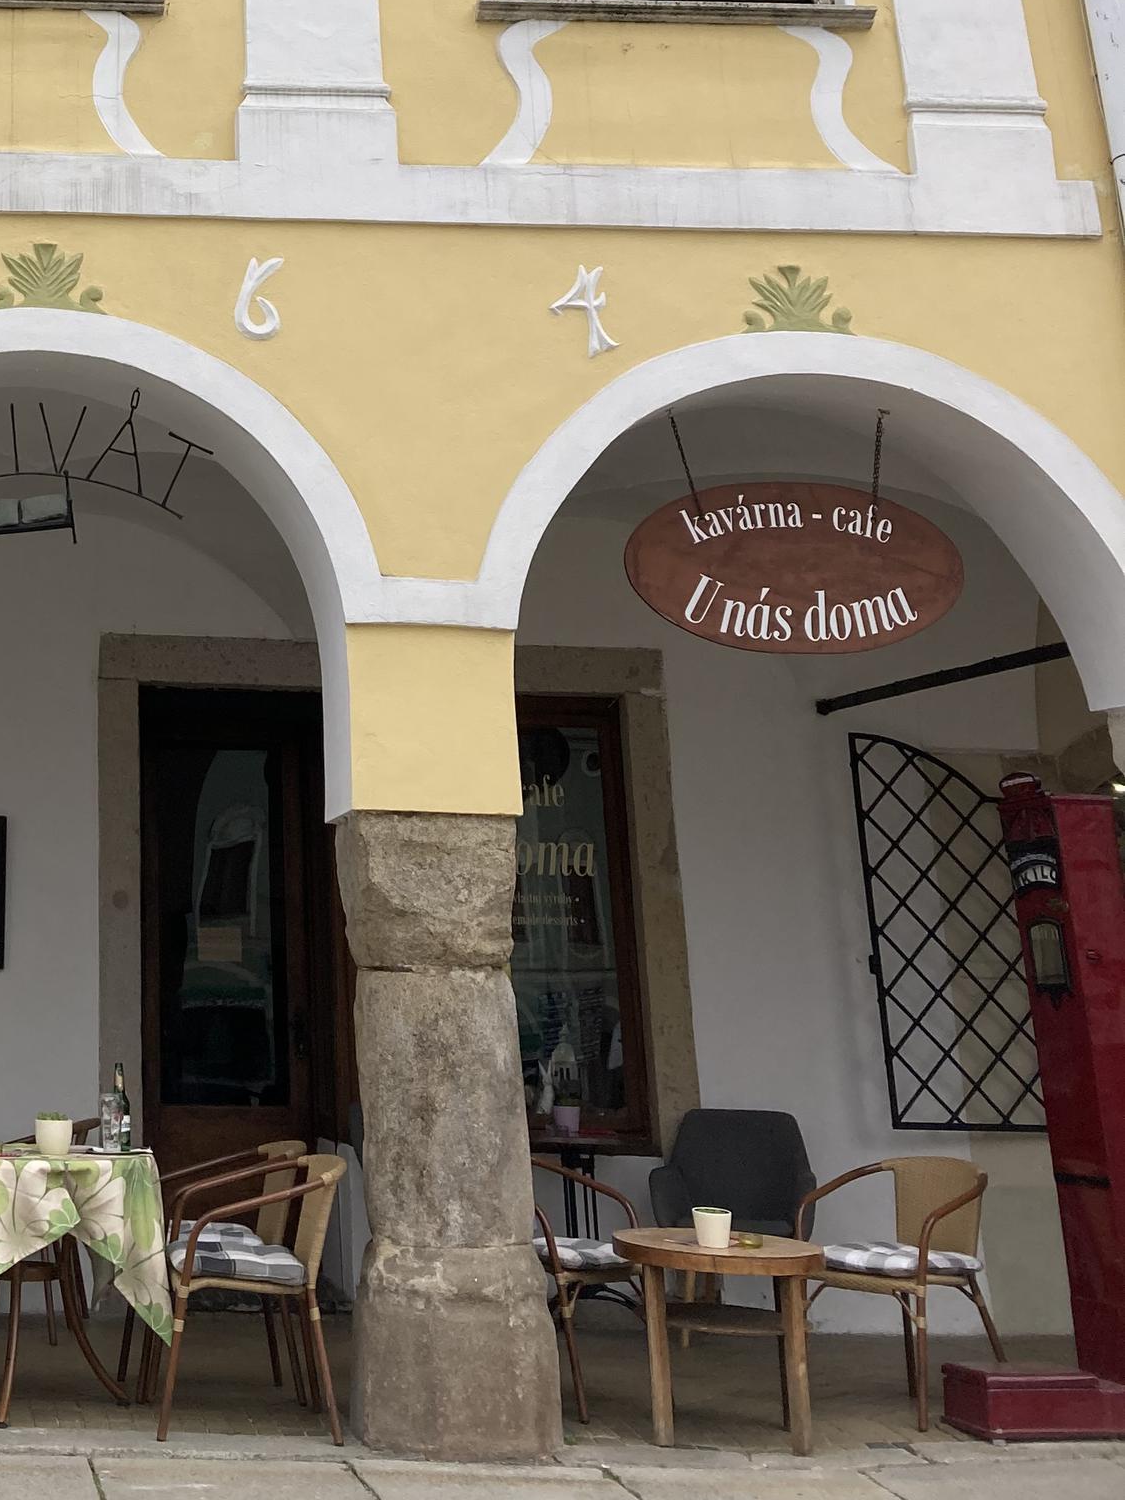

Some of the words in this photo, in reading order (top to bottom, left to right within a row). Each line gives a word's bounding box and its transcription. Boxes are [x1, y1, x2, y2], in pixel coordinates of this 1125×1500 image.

[234, 256, 285, 341] 6
[548, 264, 622, 358] 4
[679, 494, 804, 544] kavárna
[832, 503, 893, 544] cafe
[684, 573, 725, 625] U
[719, 587, 793, 642] nás
[804, 587, 918, 642] doma
[523, 774, 565, 808] afe
[515, 839, 595, 877] oma
